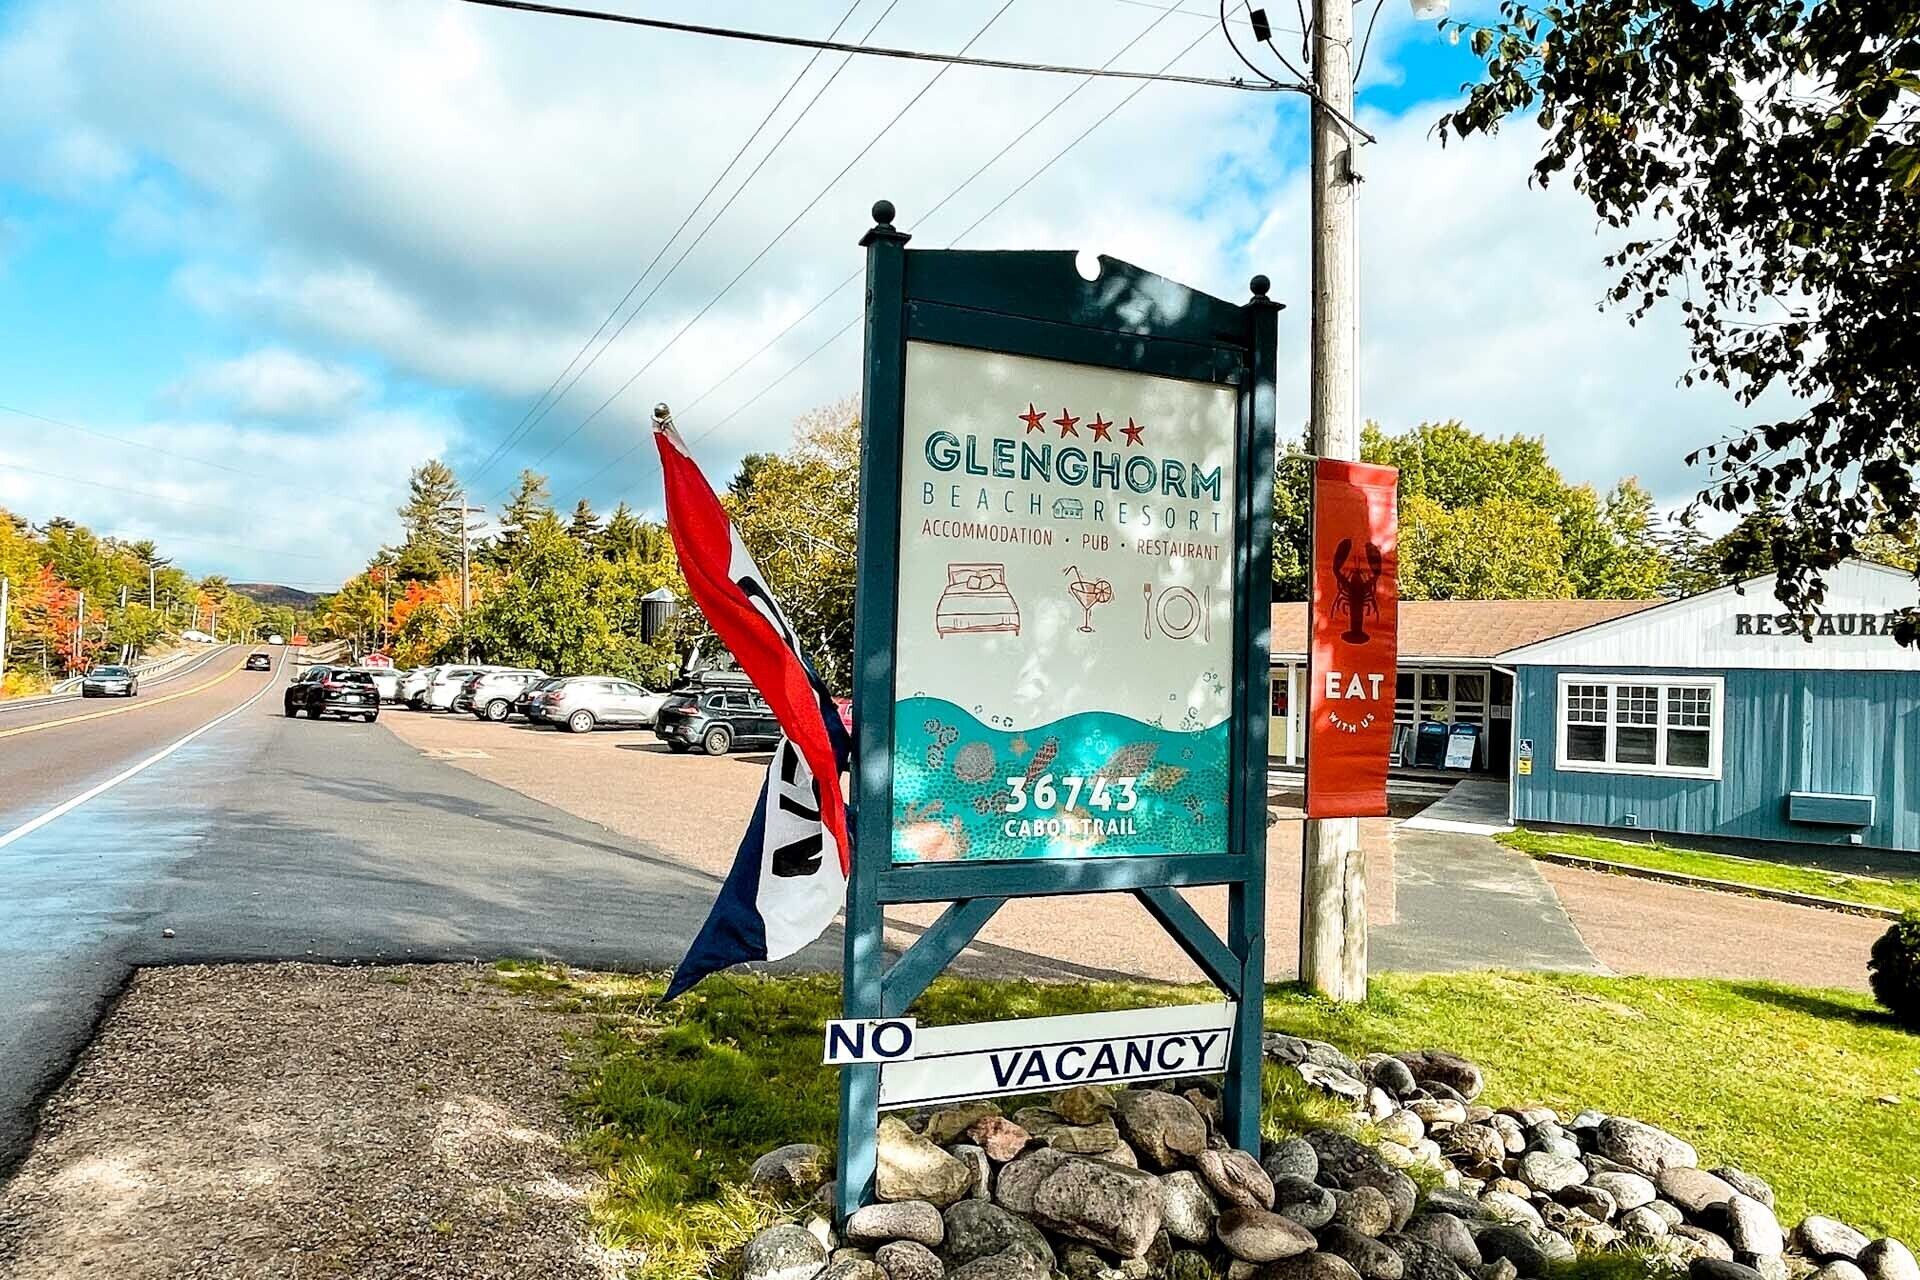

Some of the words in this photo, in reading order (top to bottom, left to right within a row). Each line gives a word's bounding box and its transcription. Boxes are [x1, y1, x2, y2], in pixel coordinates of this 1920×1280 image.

[925, 430, 1221, 501] GLENGHORM
[923, 481, 1041, 516] BEACH
[1093, 499, 1221, 533] RESORT
[921, 518, 1053, 546] ACCOMMODATION
[1082, 533, 1110, 552] PUB
[1137, 538, 1220, 561] RESTAURANT
[1325, 671, 1385, 701] EAT
[1328, 711, 1357, 733] WITH
[1360, 712, 1376, 729] US
[1004, 776, 1138, 813] 36743
[1004, 817, 1073, 838] CABOT
[1082, 817, 1137, 836] TRAIL
[828, 1021, 913, 1059] NO
[990, 1033, 1219, 1088] VACANCY
